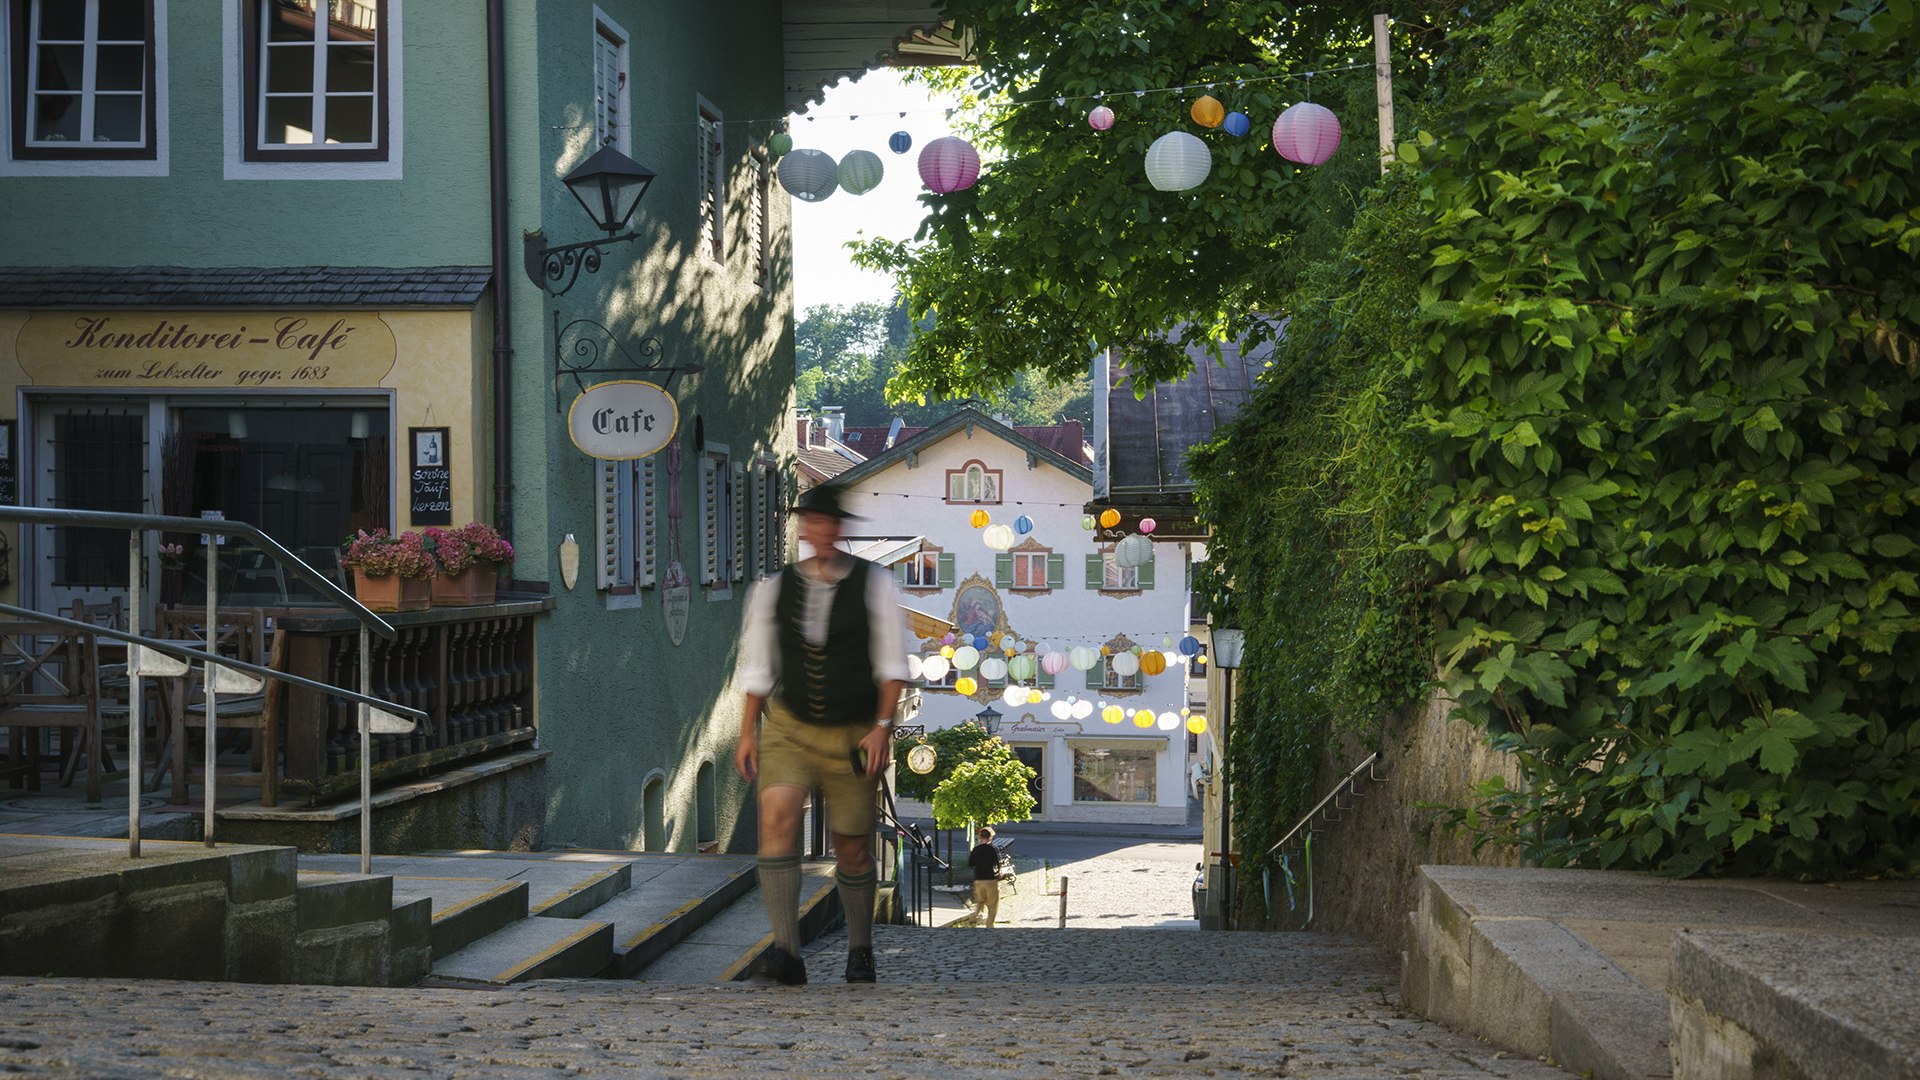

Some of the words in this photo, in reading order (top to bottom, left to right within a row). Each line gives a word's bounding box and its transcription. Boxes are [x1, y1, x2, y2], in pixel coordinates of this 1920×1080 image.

[95, 368, 132, 379] zum
[136, 360, 223, 380] Lebzelter
[234, 368, 282, 385] gegr.
[289, 365, 330, 380] 1683
[592, 407, 655, 438] Cafe
